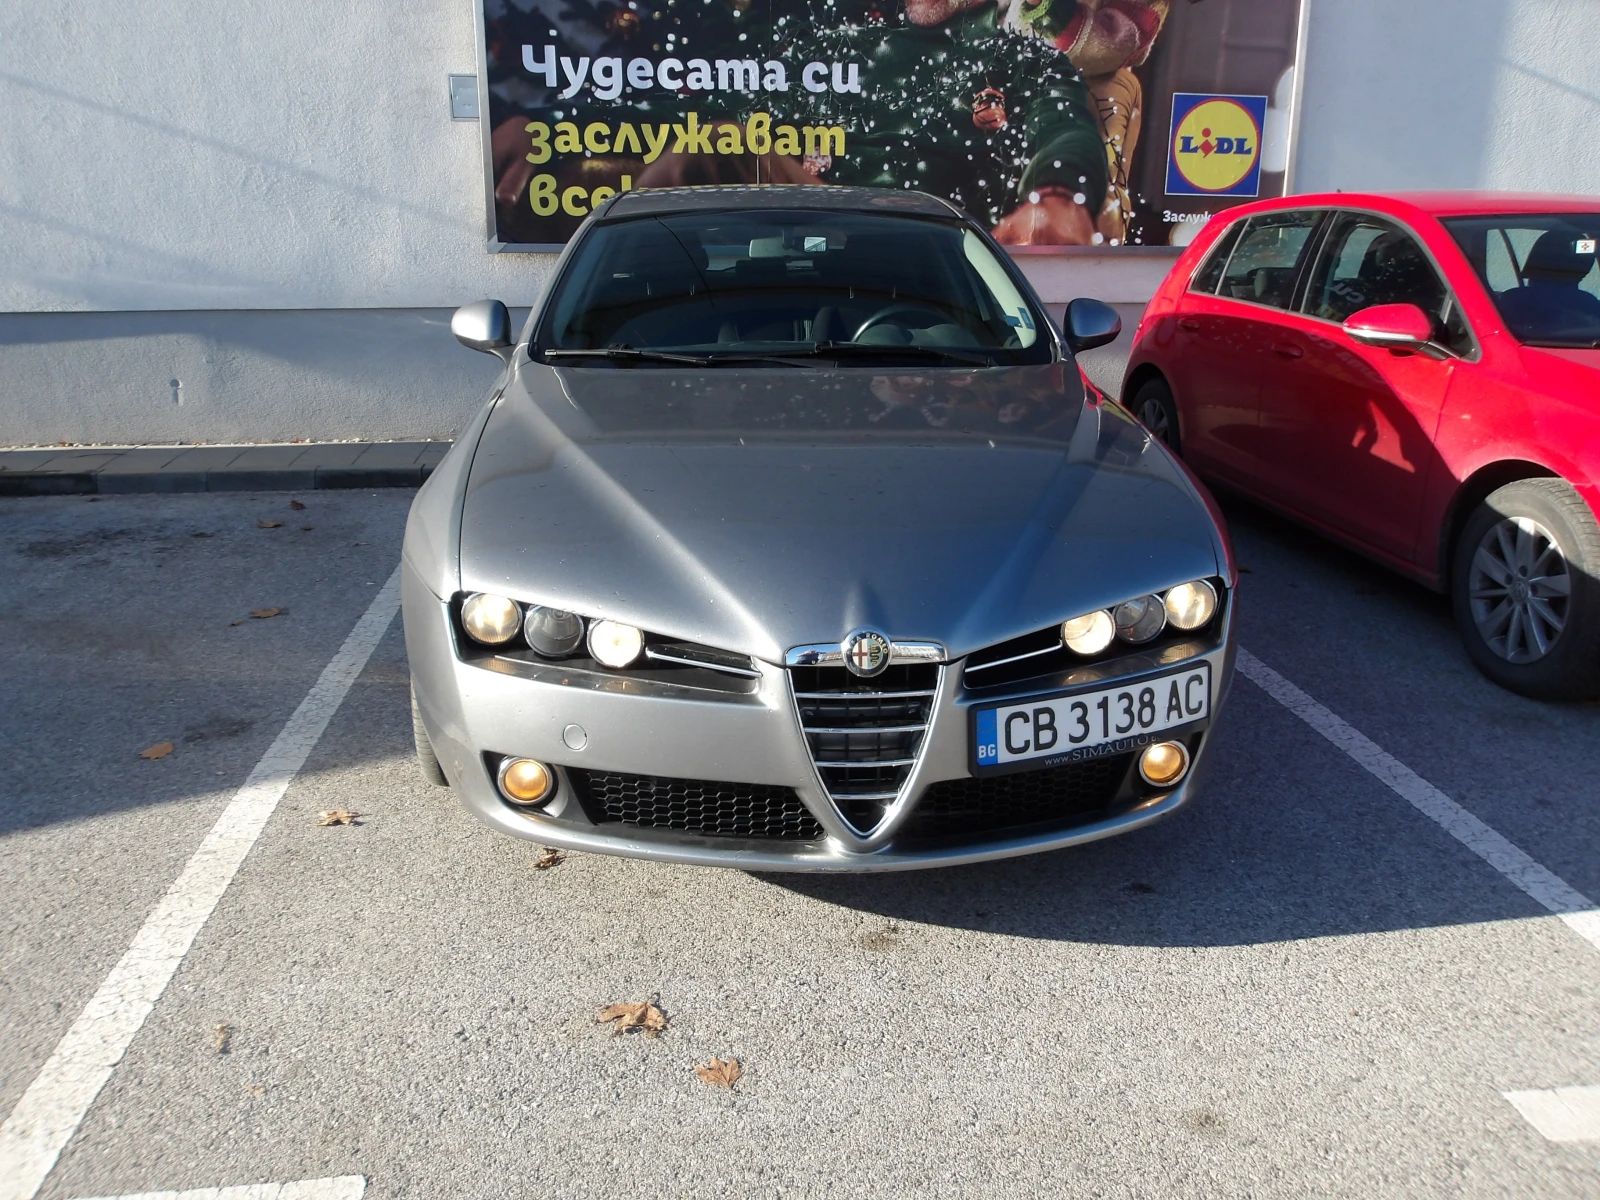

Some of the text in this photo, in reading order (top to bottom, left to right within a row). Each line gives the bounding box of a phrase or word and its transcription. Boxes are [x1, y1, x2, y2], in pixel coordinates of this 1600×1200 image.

[521, 44, 861, 100] Чудесата си
[524, 111, 846, 164] заслужават
[1162, 209, 1214, 225] Заслуж
[1004, 674, 1204, 755] CB 3138 AC
[978, 743, 997, 759] BG
